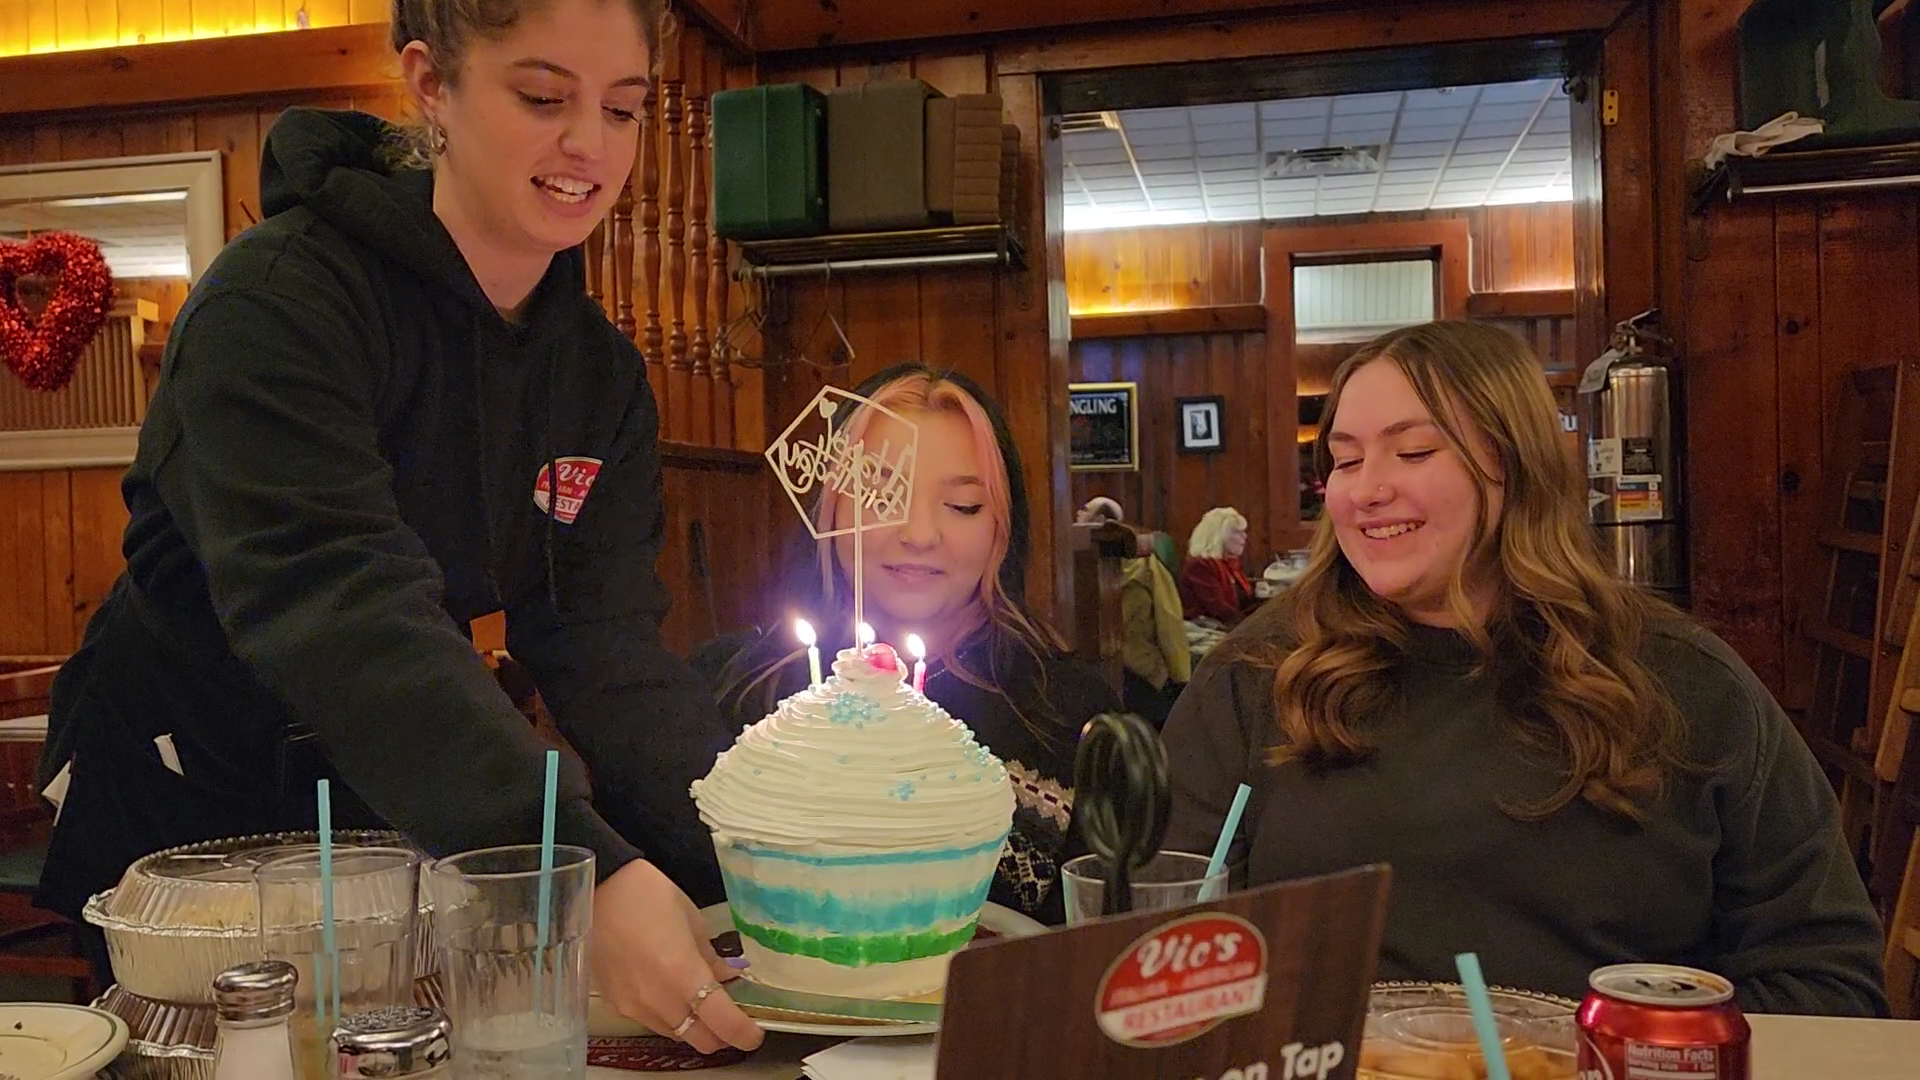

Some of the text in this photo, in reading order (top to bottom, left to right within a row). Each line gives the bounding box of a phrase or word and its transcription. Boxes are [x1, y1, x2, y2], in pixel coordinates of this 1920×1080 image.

[1136, 931, 1243, 978] Vic's
[1122, 984, 1257, 1029] RESTAURANT
[1279, 1041, 1345, 1080] Tap
[1630, 1045, 1714, 1061] Nutrition Facts
